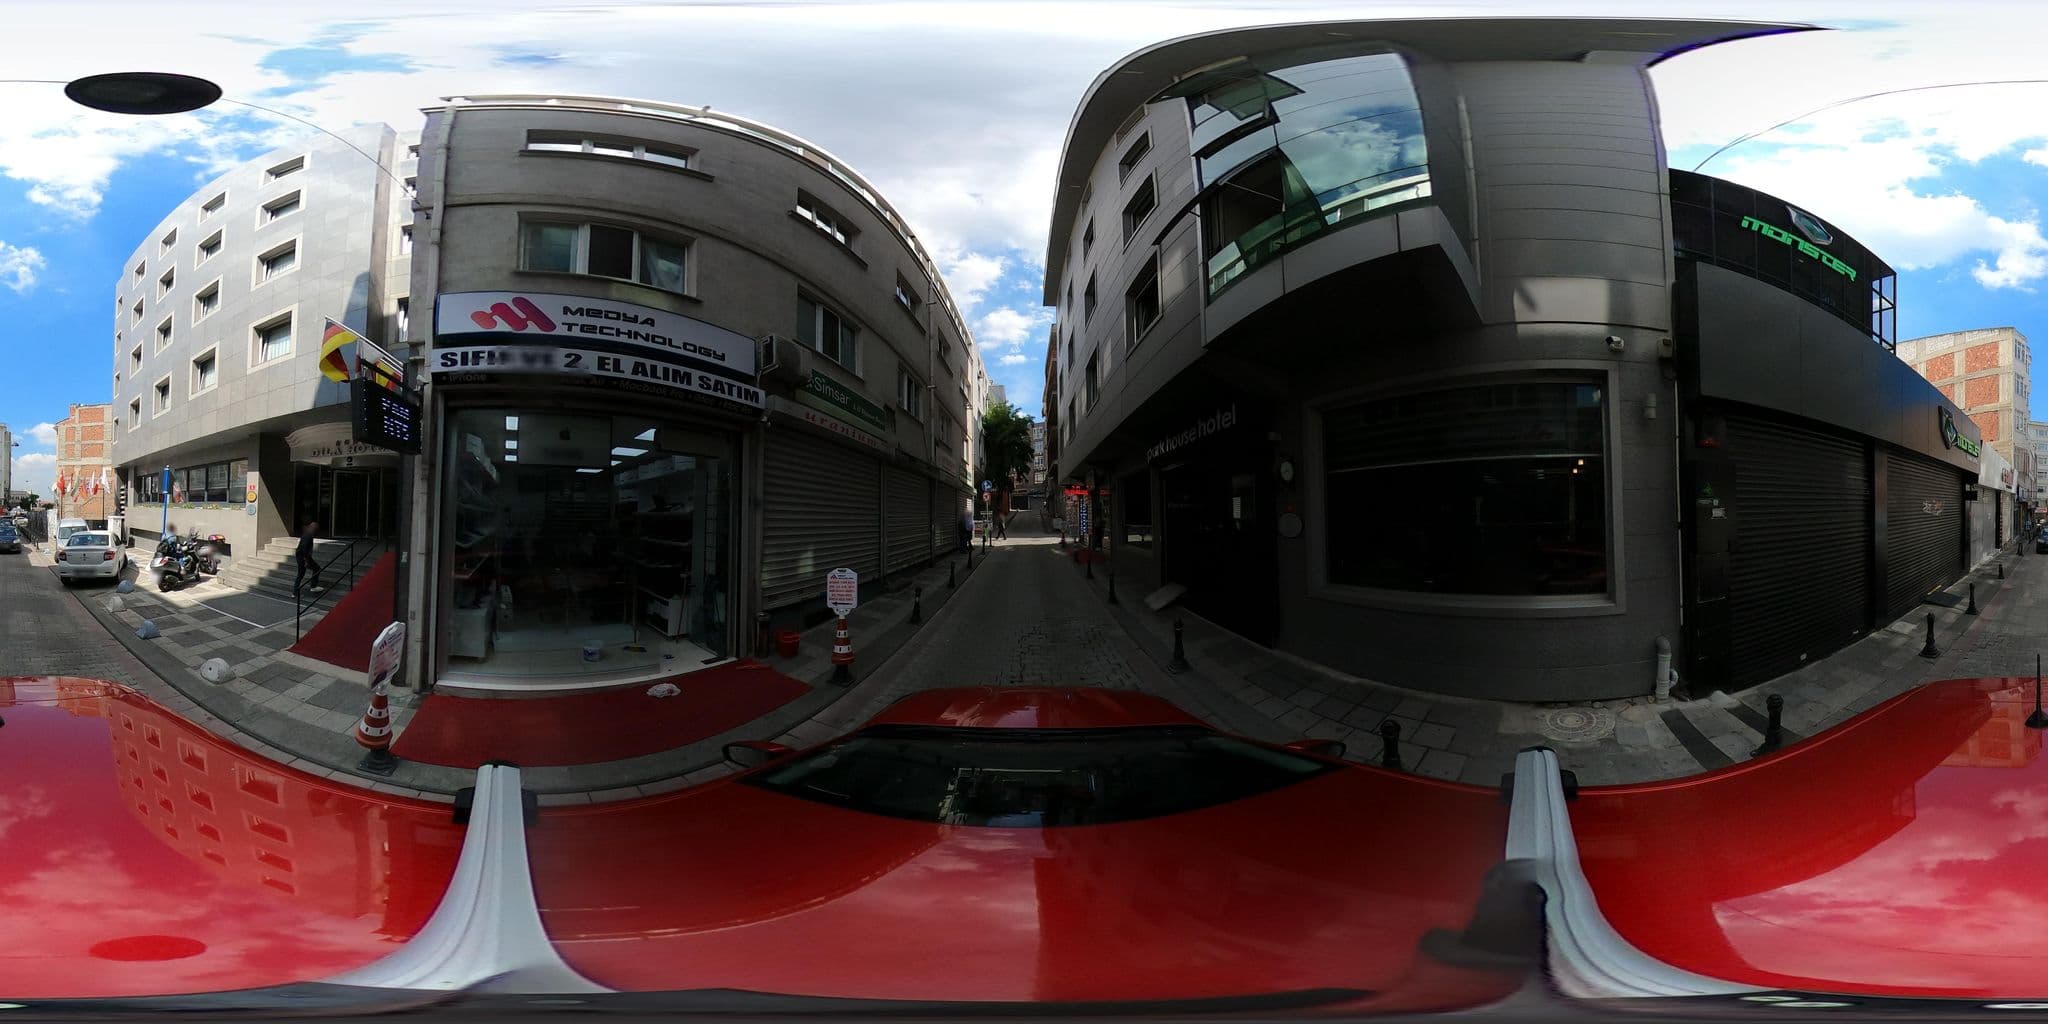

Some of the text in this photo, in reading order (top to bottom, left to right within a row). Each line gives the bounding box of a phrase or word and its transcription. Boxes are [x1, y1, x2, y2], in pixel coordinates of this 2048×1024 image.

[563, 306, 655, 327] MEDYA
[562, 322, 726, 361] TECHNOLOGY
[597, 356, 625, 373] EL
[631, 361, 692, 386] ALIM
[698, 375, 760, 403] SATIM
[814, 376, 849, 405] Simsar
[1197, 401, 1237, 440] hotel
